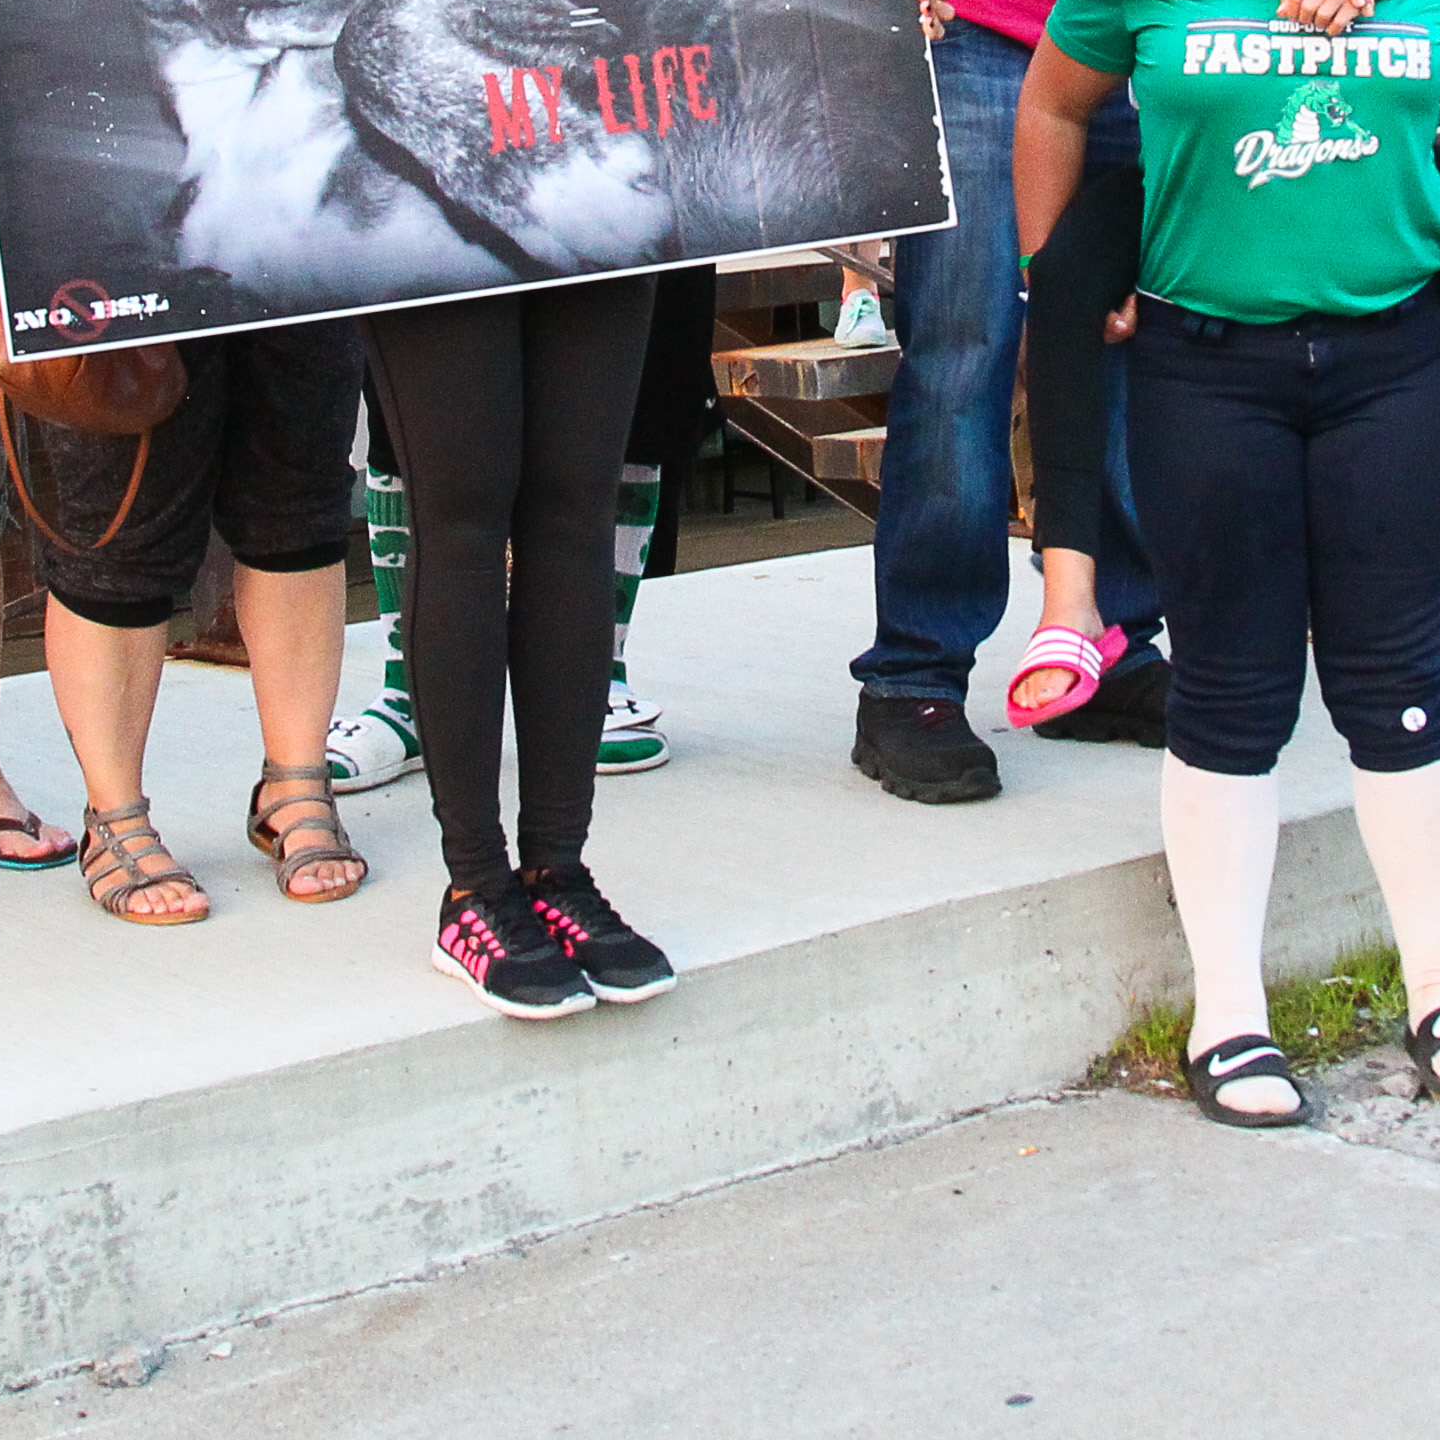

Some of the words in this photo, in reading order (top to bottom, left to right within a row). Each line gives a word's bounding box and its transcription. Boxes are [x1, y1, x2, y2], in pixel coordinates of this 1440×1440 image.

[1183, 33, 1431, 79] FASTPITCH
[482, 65, 564, 155] MY
[594, 44, 719, 138] LIFE
[1234, 129, 1380, 192] Dragons
[89, 293, 170, 321] BSL
